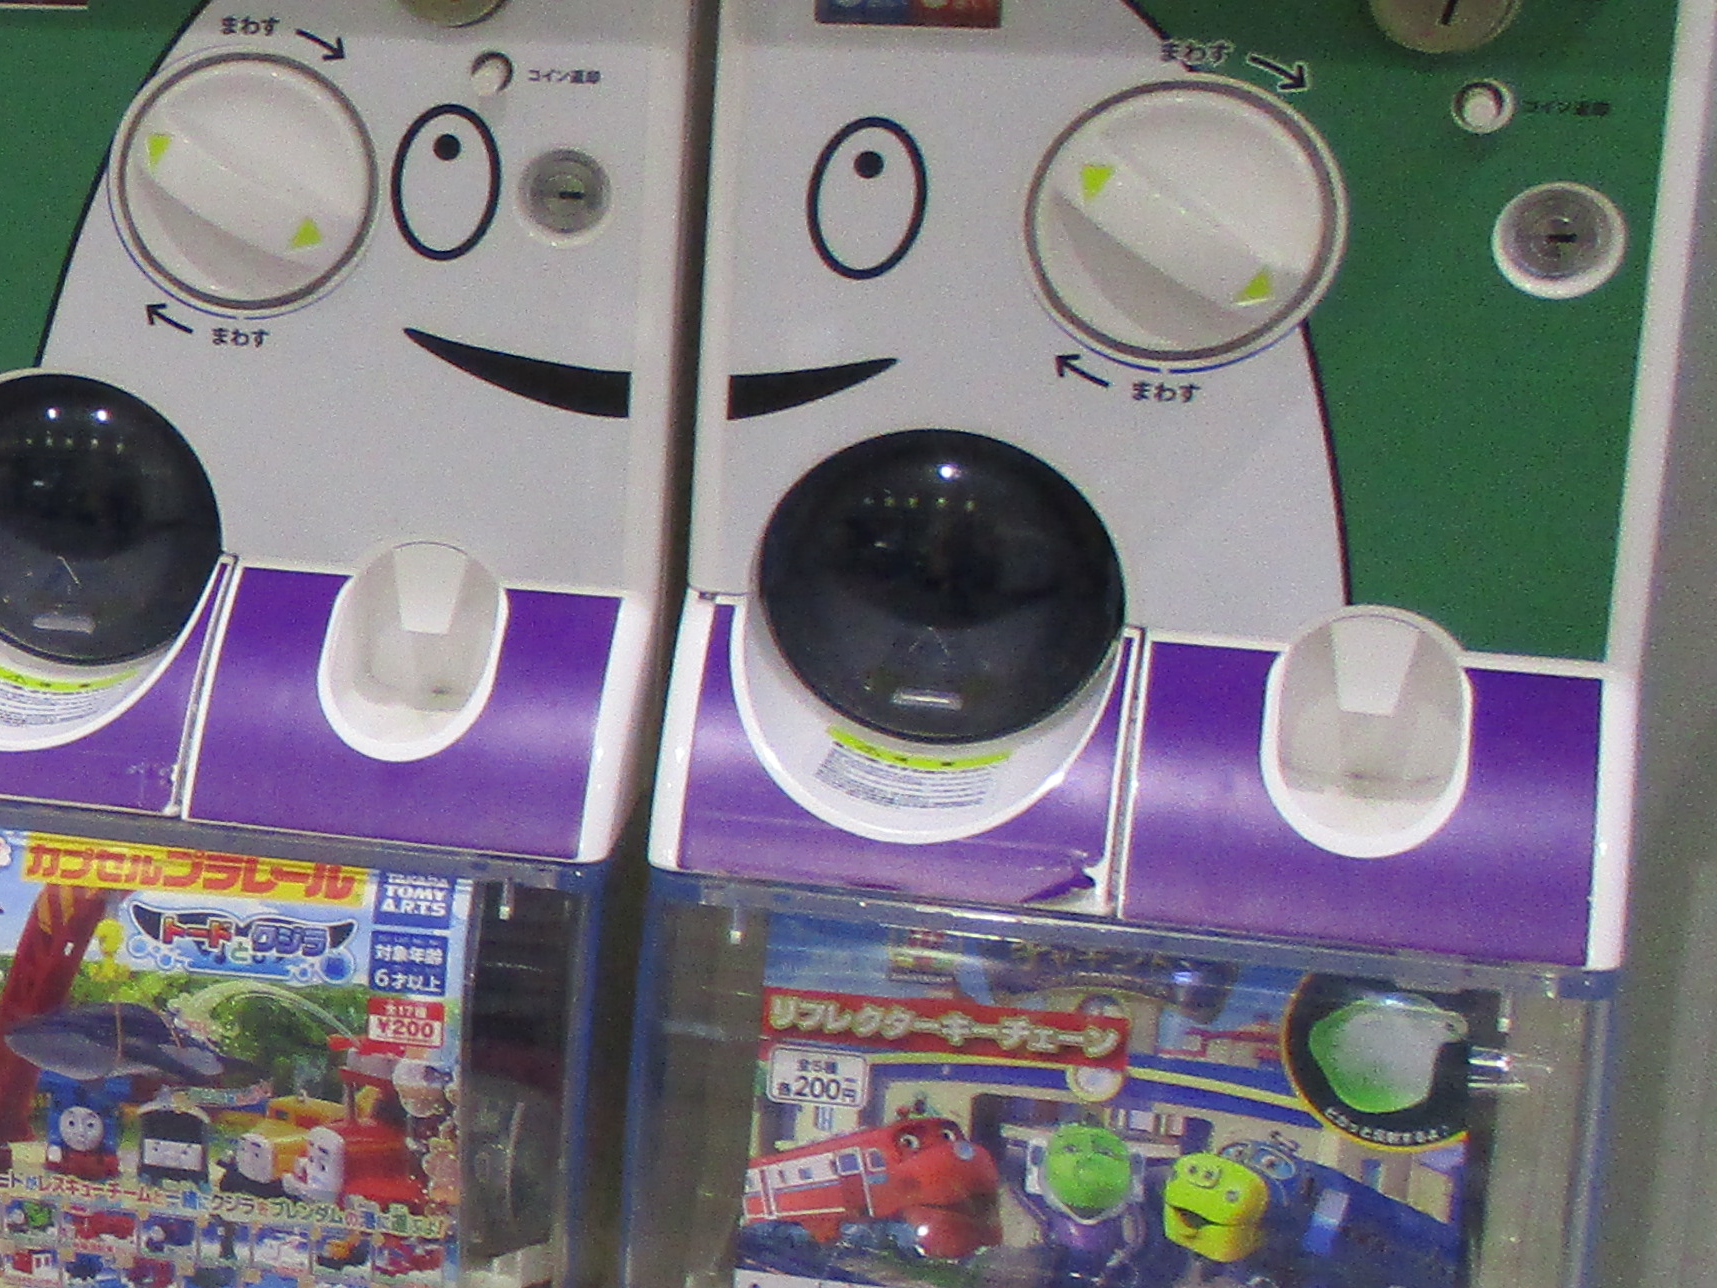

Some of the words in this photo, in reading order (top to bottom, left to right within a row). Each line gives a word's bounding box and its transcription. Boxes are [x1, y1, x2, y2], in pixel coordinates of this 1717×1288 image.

[222, 16, 281, 37] まわす
[1160, 39, 1232, 64] まわす
[211, 327, 271, 348] まわす
[1131, 381, 1202, 404] まわす
[26, 842, 356, 901] カプセルプラレール
[385, 884, 447, 902] TOMY
[373, 943, 445, 968] 対象年齢
[372, 967, 442, 994] 6才以上
[376, 1018, 435, 1040] ¥200
[769, 994, 1120, 1058] リフレクターキーチェーン
